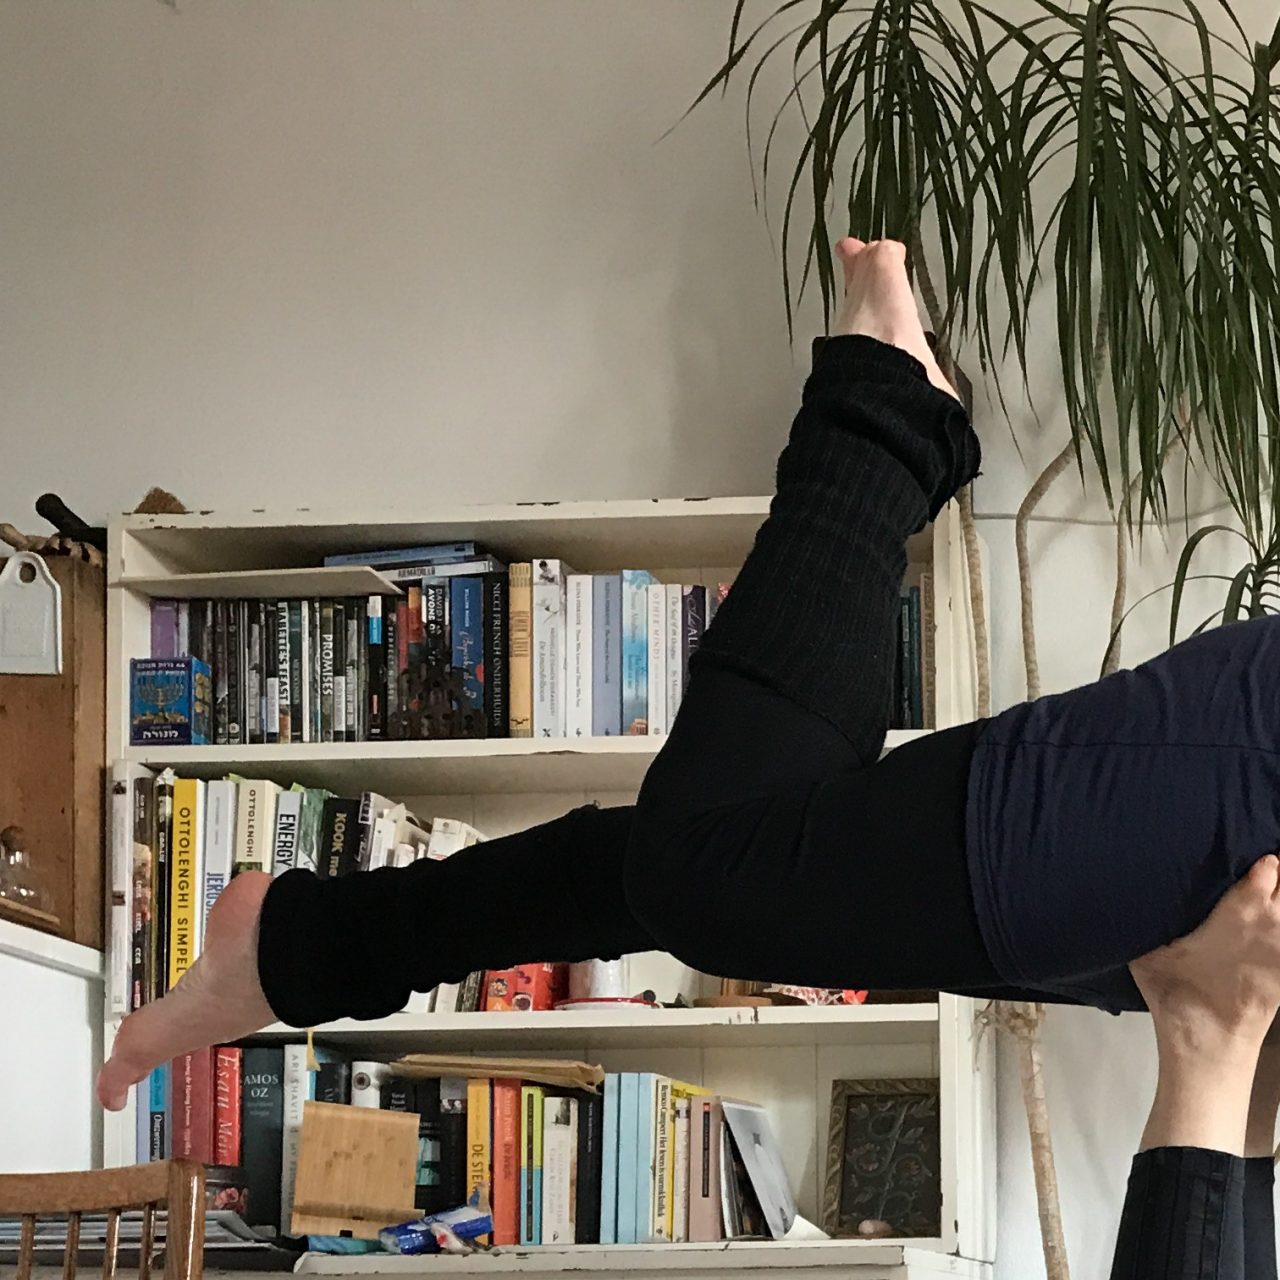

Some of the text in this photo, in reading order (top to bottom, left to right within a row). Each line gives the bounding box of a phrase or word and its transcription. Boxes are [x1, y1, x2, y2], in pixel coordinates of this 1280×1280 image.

[493, 583, 501, 611] NICCI
[652, 592, 660, 624] OTHER
[493, 614, 502, 655] FRENCH
[652, 629, 660, 660] MINDS
[278, 607, 288, 701] BABETTE'S FEAST
[322, 634, 333, 695] PROMISES
[246, 789, 256, 858] OTTOLENGHI
[276, 813, 296, 867] ENERGY
[332, 812, 347, 853] KOOK
[176, 807, 190, 974] OTTOLENGHI SIMPEL
[244, 1074, 279, 1085] AMOS
[290, 1054, 299, 1073] ARI
[217, 1052, 239, 1157] Esau Meir
[251, 1087, 269, 1098] OZ
[290, 1079, 299, 1121] SHAVIT
[659, 1107, 667, 1135] Campert
[472, 1144, 484, 1158] DE
[659, 1136, 667, 1148] Het
